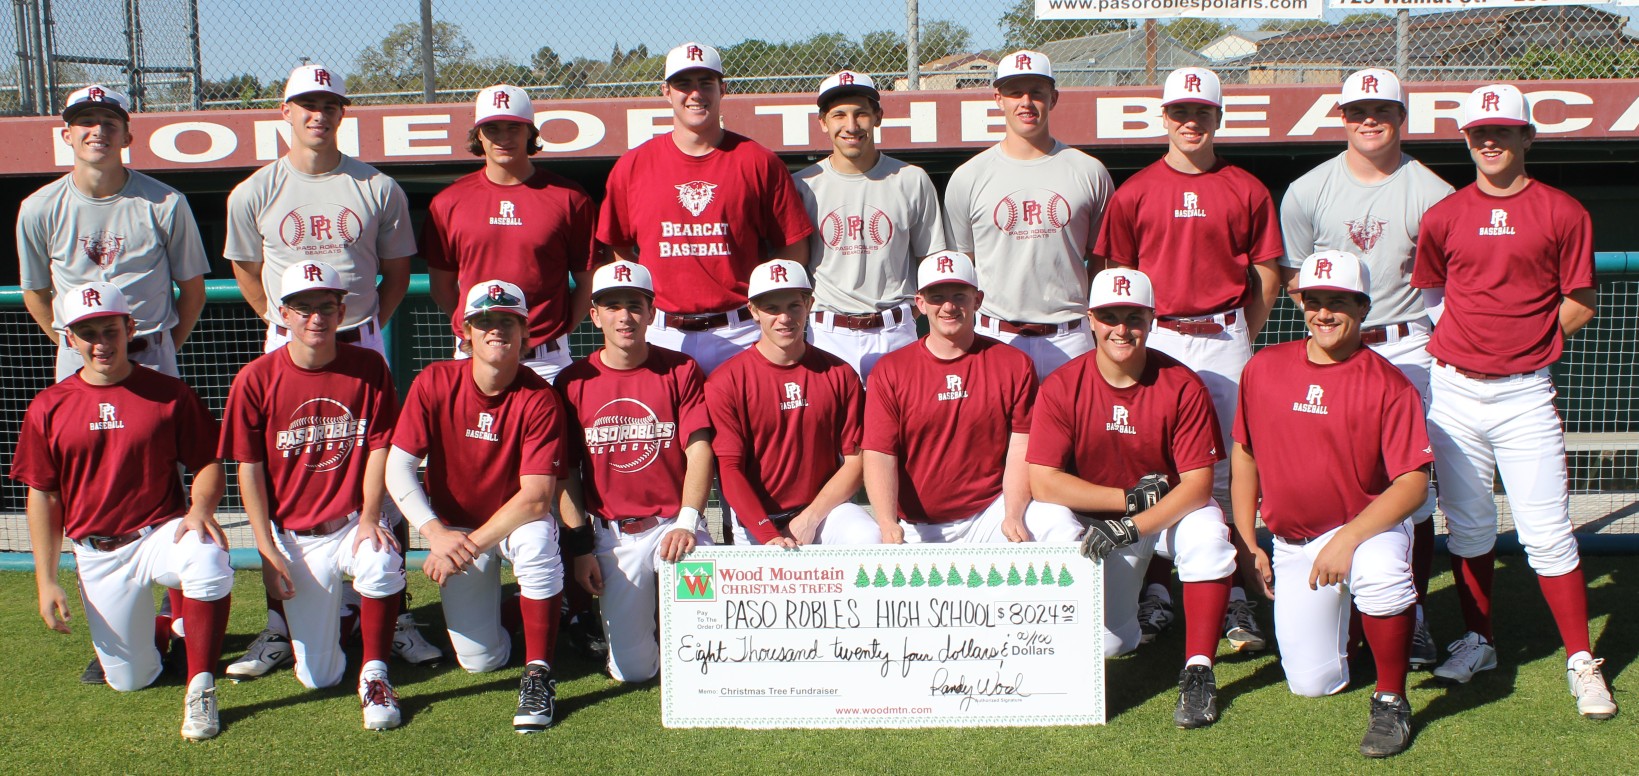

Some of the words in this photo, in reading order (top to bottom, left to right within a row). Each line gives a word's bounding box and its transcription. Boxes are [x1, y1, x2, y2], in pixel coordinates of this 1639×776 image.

[1049, 0, 1307, 12] www.pasoroblespolaris.com
[686, 45, 703, 61] PR
[1014, 54, 1032, 71] PR
[315, 68, 331, 87] PR
[1184, 74, 1199, 93] PR
[1361, 74, 1379, 94] PR
[494, 90, 510, 109] PR
[1481, 91, 1499, 111] PR
[500, 201, 515, 218] PR
[1183, 192, 1198, 210] PR
[489, 217, 523, 226] BASEBALL
[1022, 200, 1042, 225] PR
[1490, 208, 1508, 228] PR
[310, 215, 332, 241] PR
[661, 221, 728, 237] BEARCAT
[1479, 226, 1515, 236] BASEBALL
[304, 249, 342, 257] BEARCATS
[319, 243, 349, 251] ROBLES
[659, 241, 731, 258] BASEBALL
[303, 263, 324, 282] PR
[613, 264, 632, 282] PR
[769, 264, 788, 282] PR
[936, 255, 954, 273] PR
[1314, 258, 1333, 279] PR
[1112, 275, 1130, 296] PR
[81, 287, 103, 307] PR
[784, 382, 801, 400] PR
[946, 374, 962, 392] PR
[1305, 384, 1324, 405] PR
[99, 402, 115, 422] PR
[1113, 404, 1129, 425] PR
[1292, 402, 1328, 415] BASEBALL
[89, 420, 124, 431] BASEBALL
[477, 412, 493, 433] PR
[1106, 422, 1136, 435] BASBALL
[277, 425, 316, 450] PASO
[316, 419, 367, 443] ROBLES
[465, 429, 498, 442] BASEBALL
[585, 427, 620, 446] PASO
[620, 422, 675, 443] ROBLES
[283, 439, 363, 458] BEARCAS
[590, 440, 670, 455] BEARCAS
[719, 567, 763, 583] Wood
[770, 567, 844, 582] Mountain
[683, 576, 712, 597] W
[721, 583, 797, 595] CHRISTMAS
[799, 583, 843, 593] TREES
[725, 600, 777, 629] PASO
[786, 599, 860, 630] ROBLES
[877, 598, 920, 628] HIGH
[928, 598, 996, 628] SCHOOL
[677, 635, 728, 675] Eight
[728, 635, 824, 663] Thousand
[831, 636, 892, 678] twenty
[902, 636, 933, 678] four
[938, 634, 999, 663] dollars
[1011, 645, 1055, 656] Dollars
[720, 687, 766, 695] Christmas
[769, 687, 788, 695] Tree
[790, 687, 839, 695] Fundraiser
[930, 667, 977, 711] Randy
[835, 706, 932, 715] www.woodmtn.com
